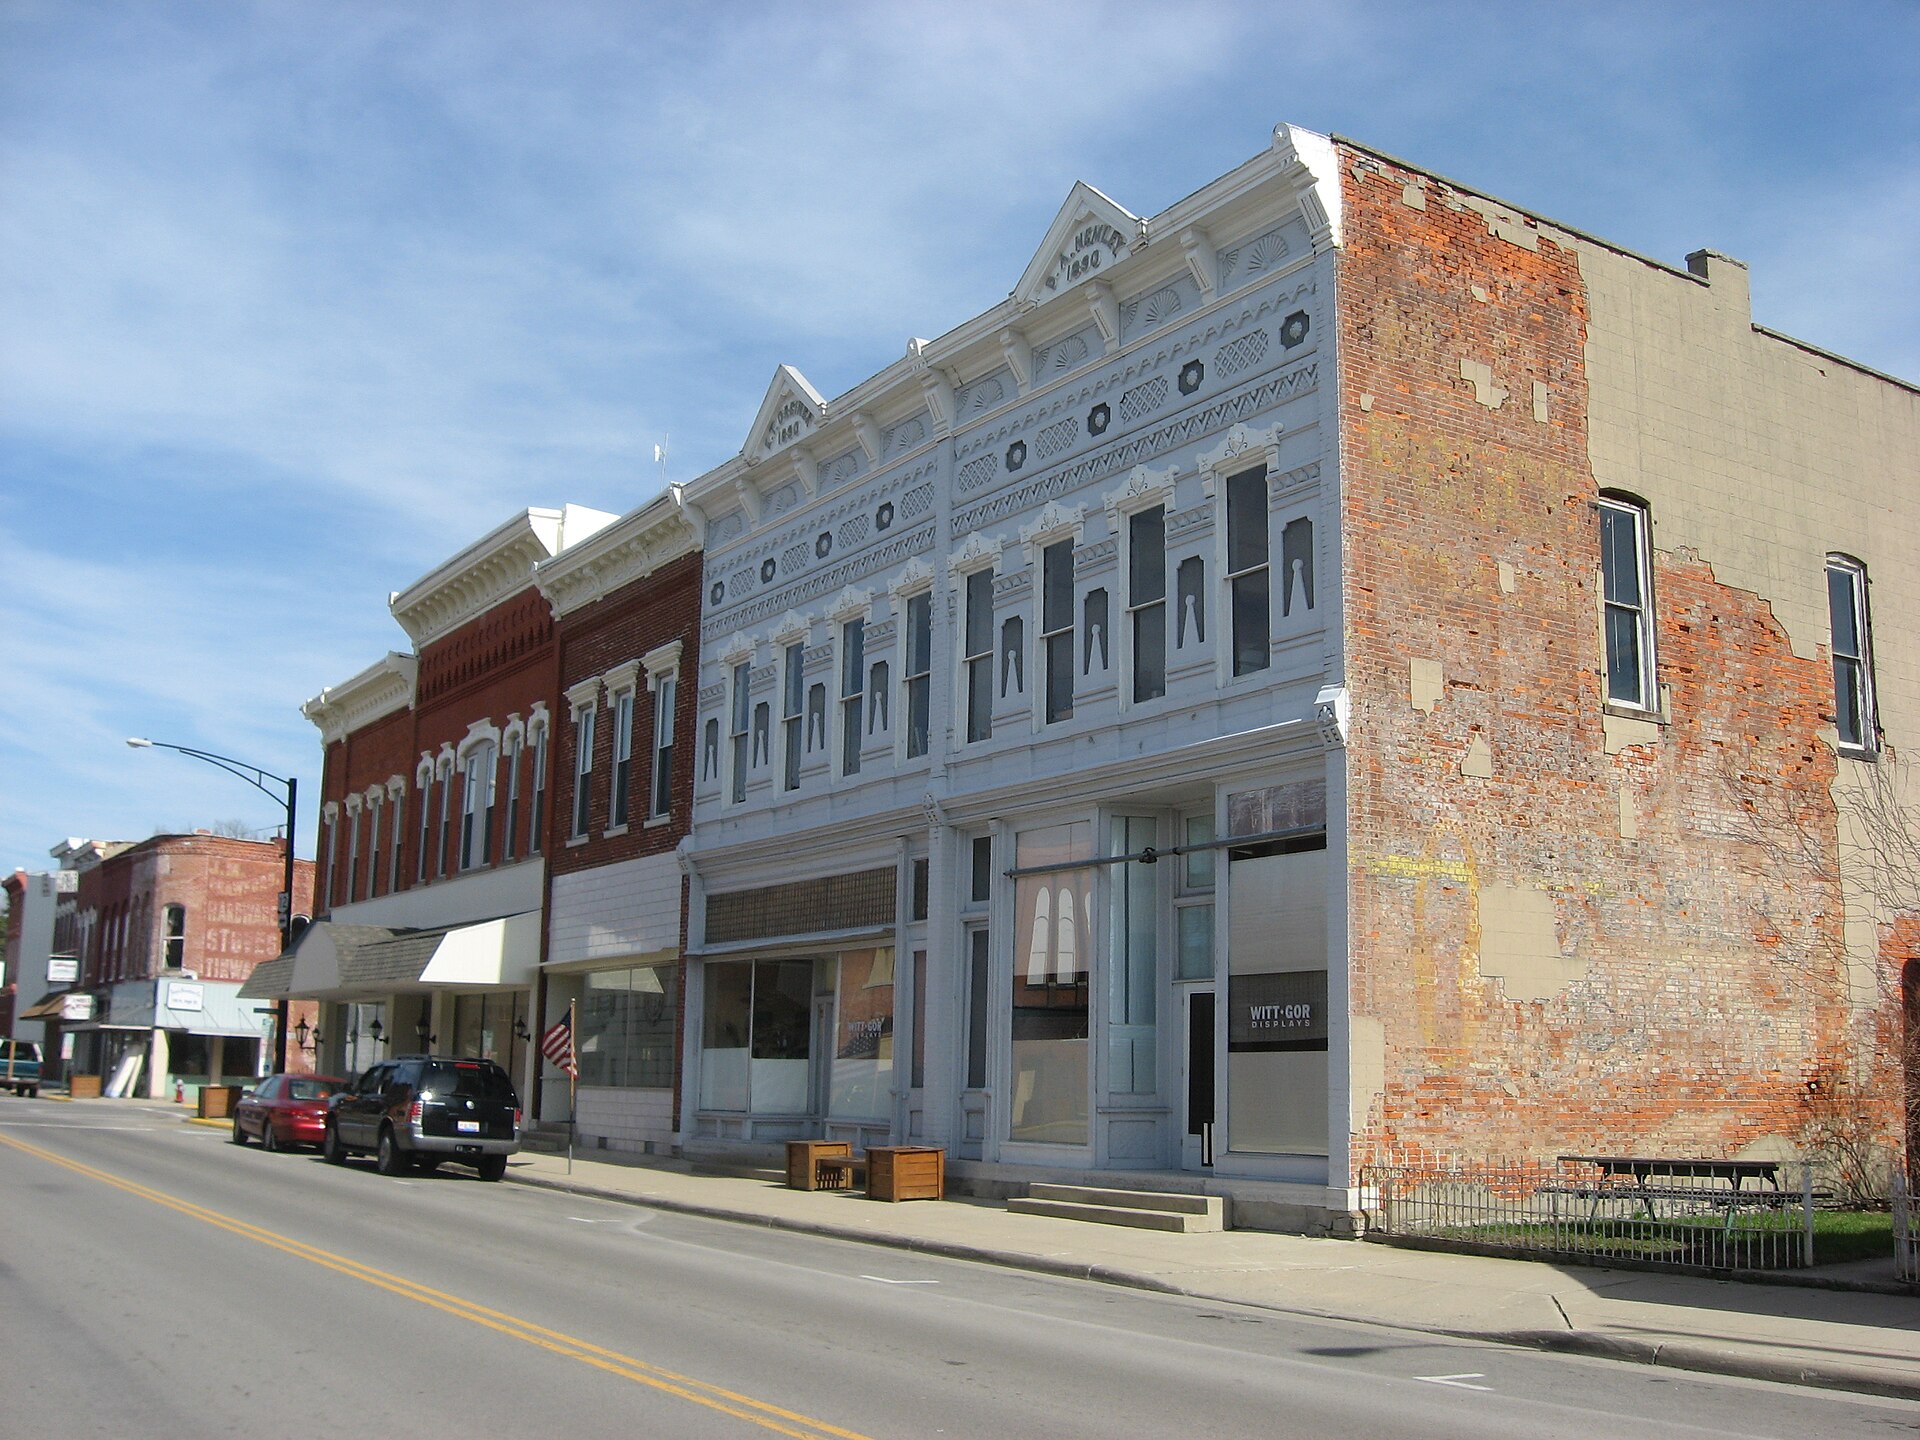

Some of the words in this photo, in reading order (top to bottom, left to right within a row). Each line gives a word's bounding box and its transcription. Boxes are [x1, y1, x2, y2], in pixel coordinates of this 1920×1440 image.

[1067, 249, 1101, 281] 1890
[778, 421, 799, 444] 1890
[1252, 1020, 1310, 1028] DISPLAYS
